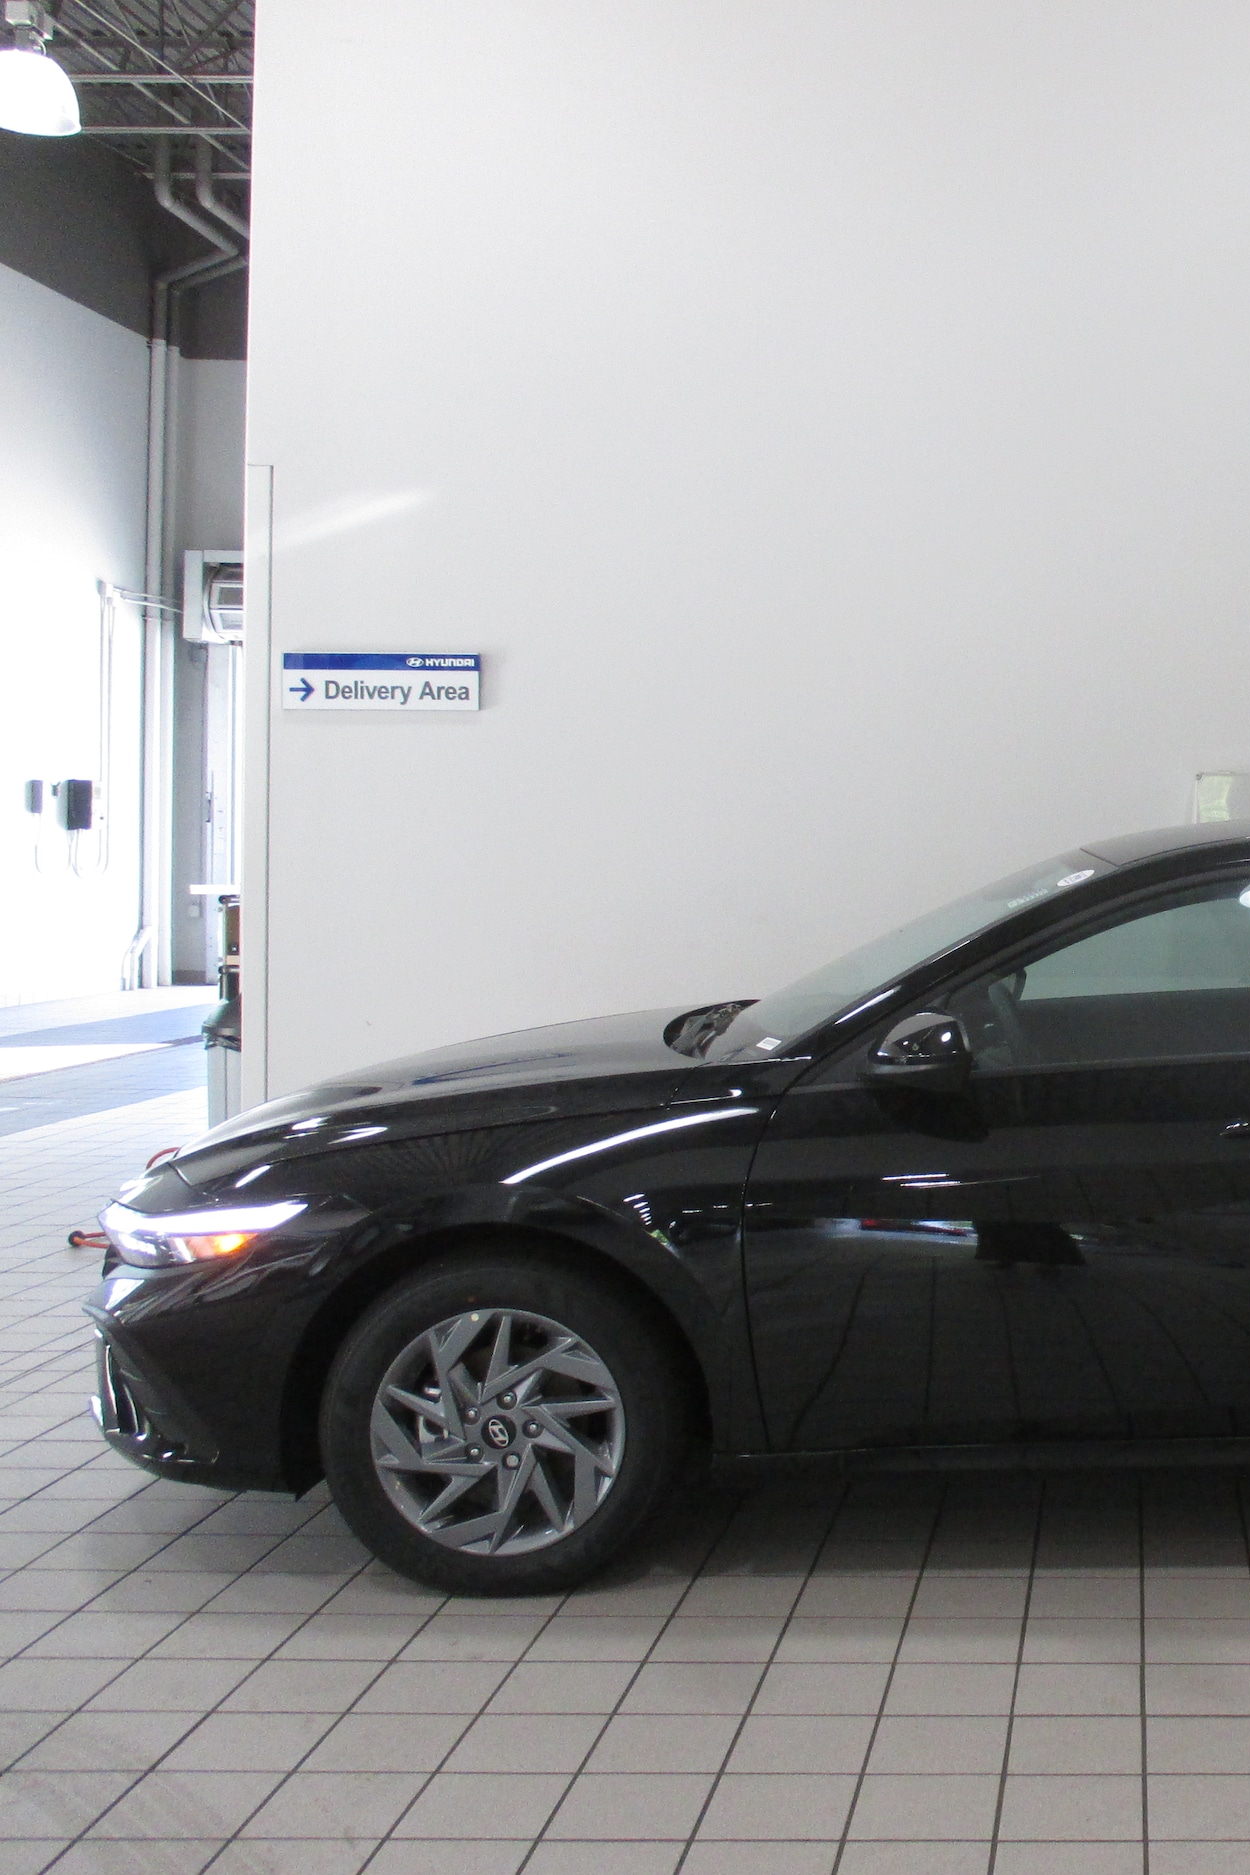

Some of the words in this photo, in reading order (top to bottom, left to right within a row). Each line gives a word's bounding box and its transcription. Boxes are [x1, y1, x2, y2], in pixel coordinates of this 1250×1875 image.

[425, 658, 474, 667] HYUNDAI
[324, 680, 412, 705] Delivery
[418, 681, 470, 701] Area
